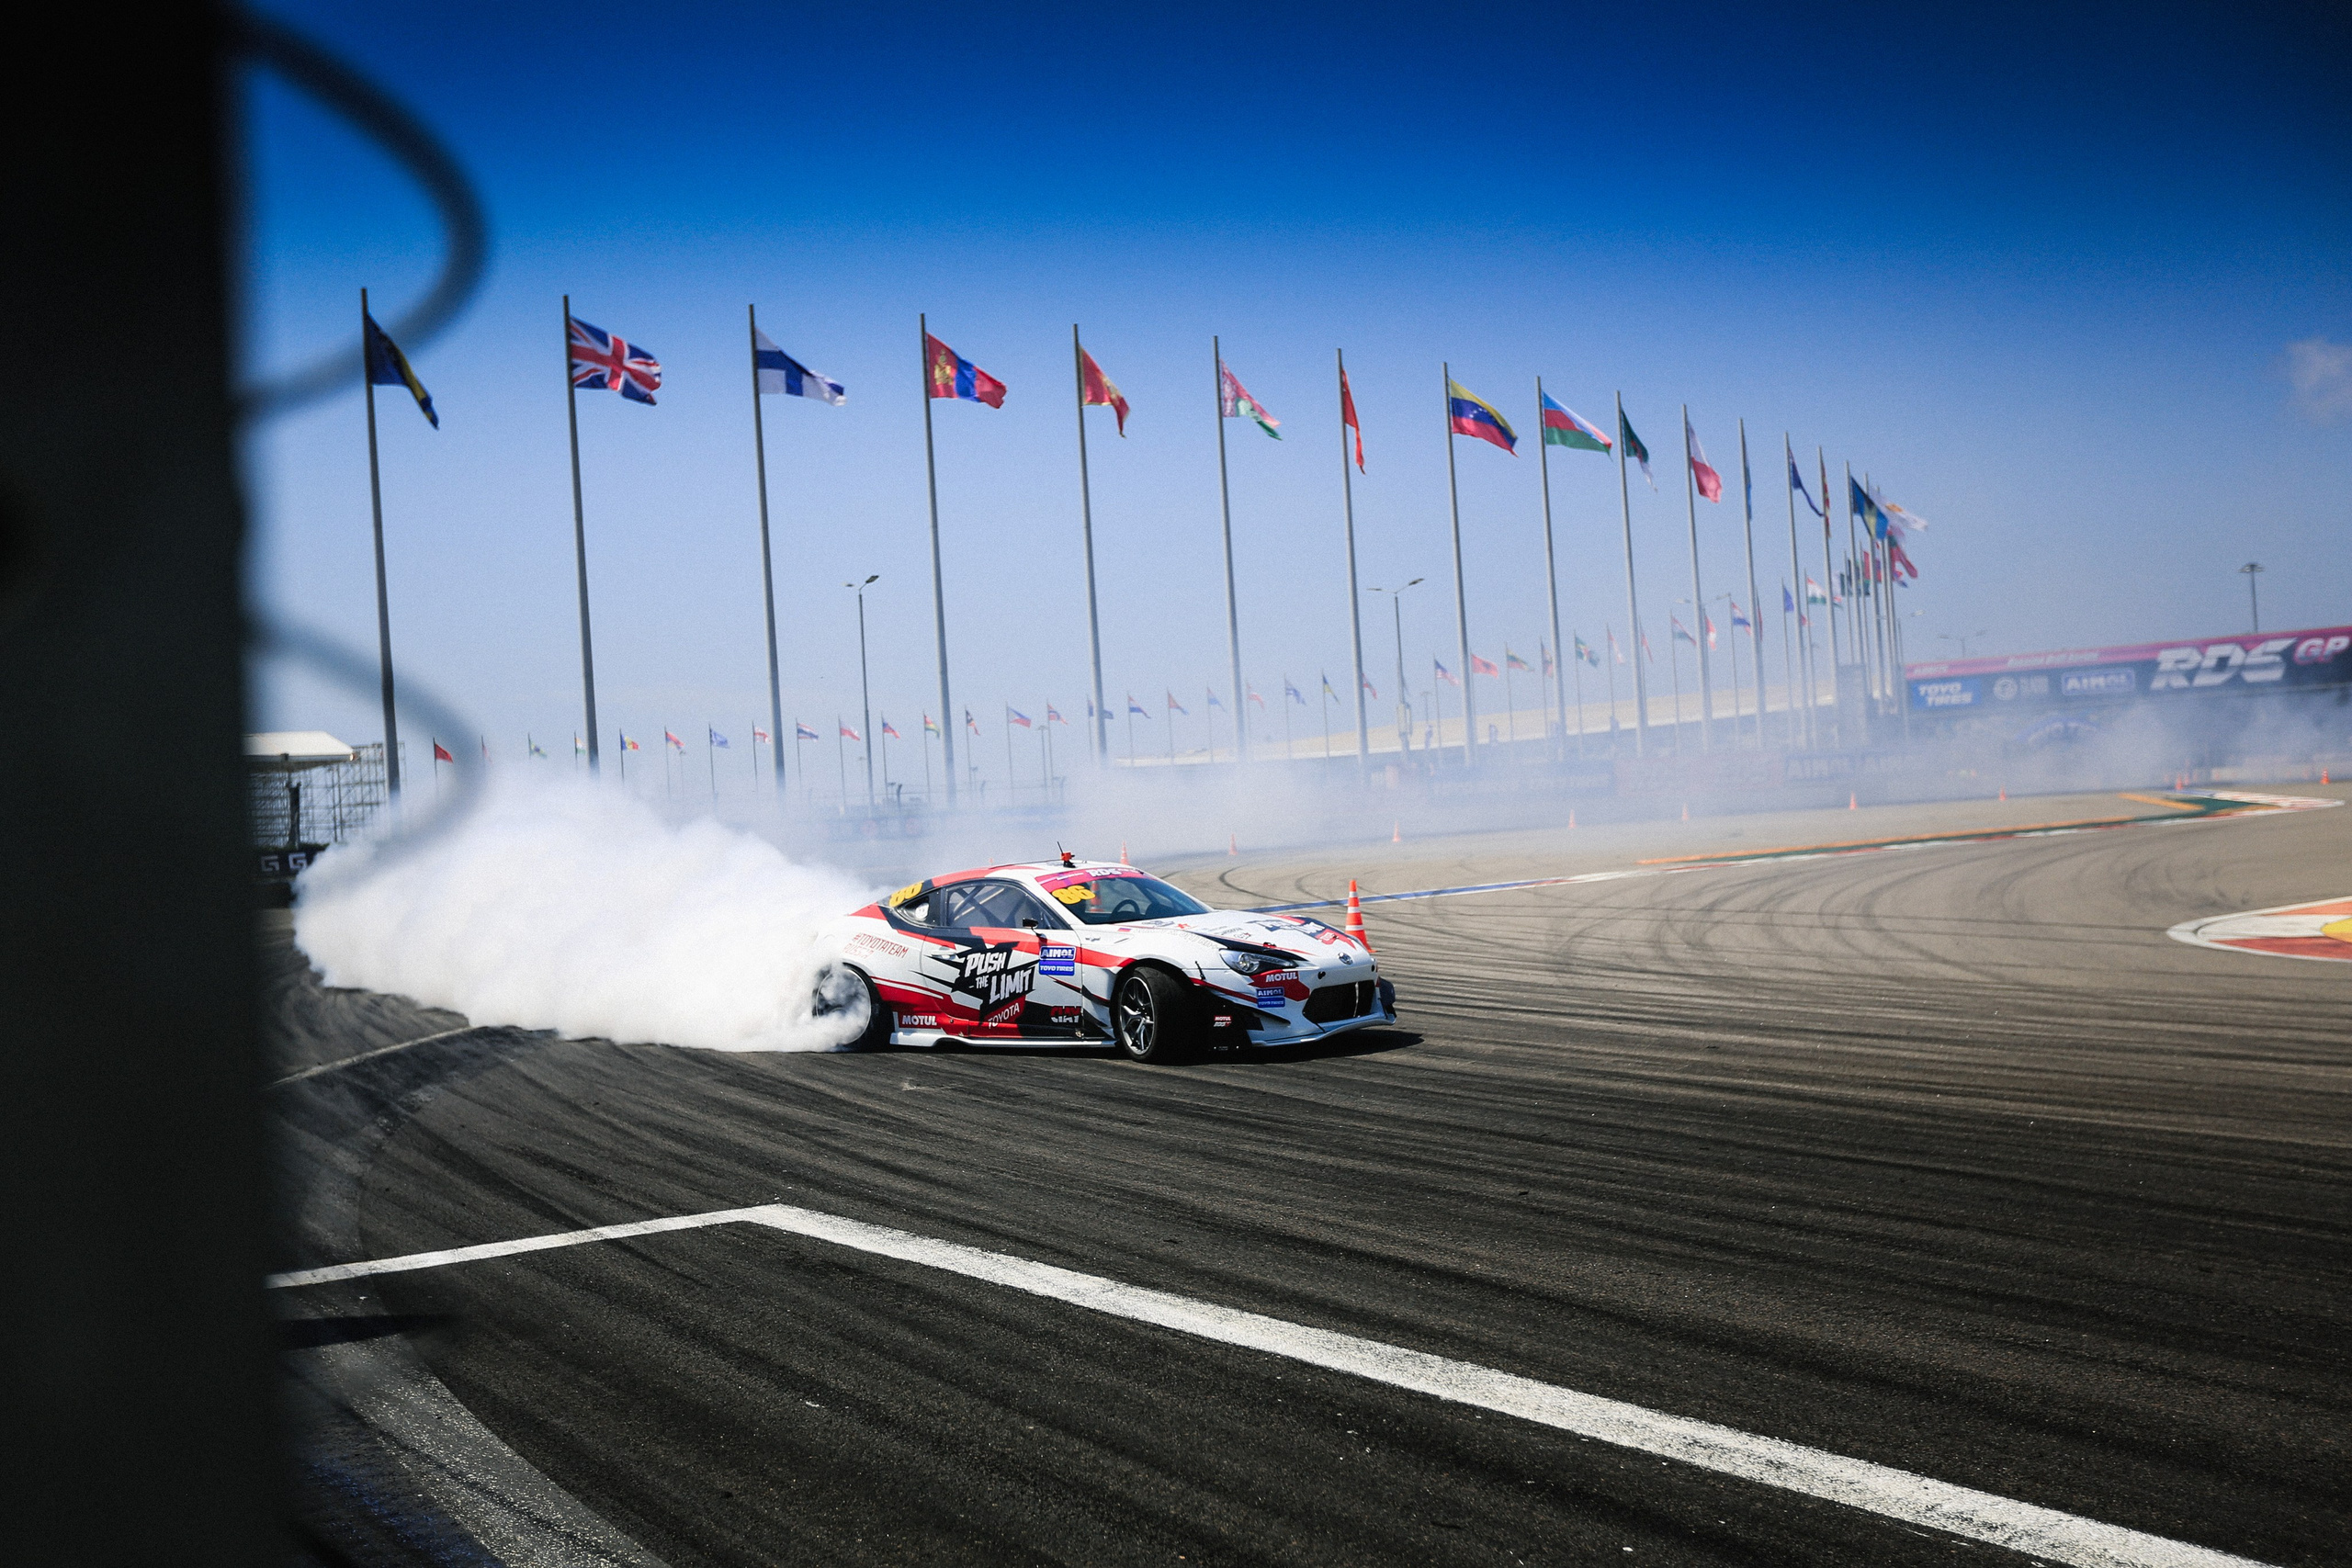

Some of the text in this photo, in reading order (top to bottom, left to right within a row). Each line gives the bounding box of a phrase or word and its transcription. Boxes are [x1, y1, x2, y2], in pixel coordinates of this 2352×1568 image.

[2150, 636, 2350, 690] RDS GP
[1918, 682, 1962, 696] TOYO
[1051, 885, 1096, 904] 86
[852, 932, 910, 958] #TOYOTATEAM
[1041, 948, 1074, 958] AIMOL
[965, 952, 1007, 977] PUSH
[976, 969, 1032, 1004] THE LIMIT
[1265, 972, 1297, 983] MOTUL
[902, 1015, 937, 1026] MOTUL
[988, 1002, 1020, 1029] TOYOTA
